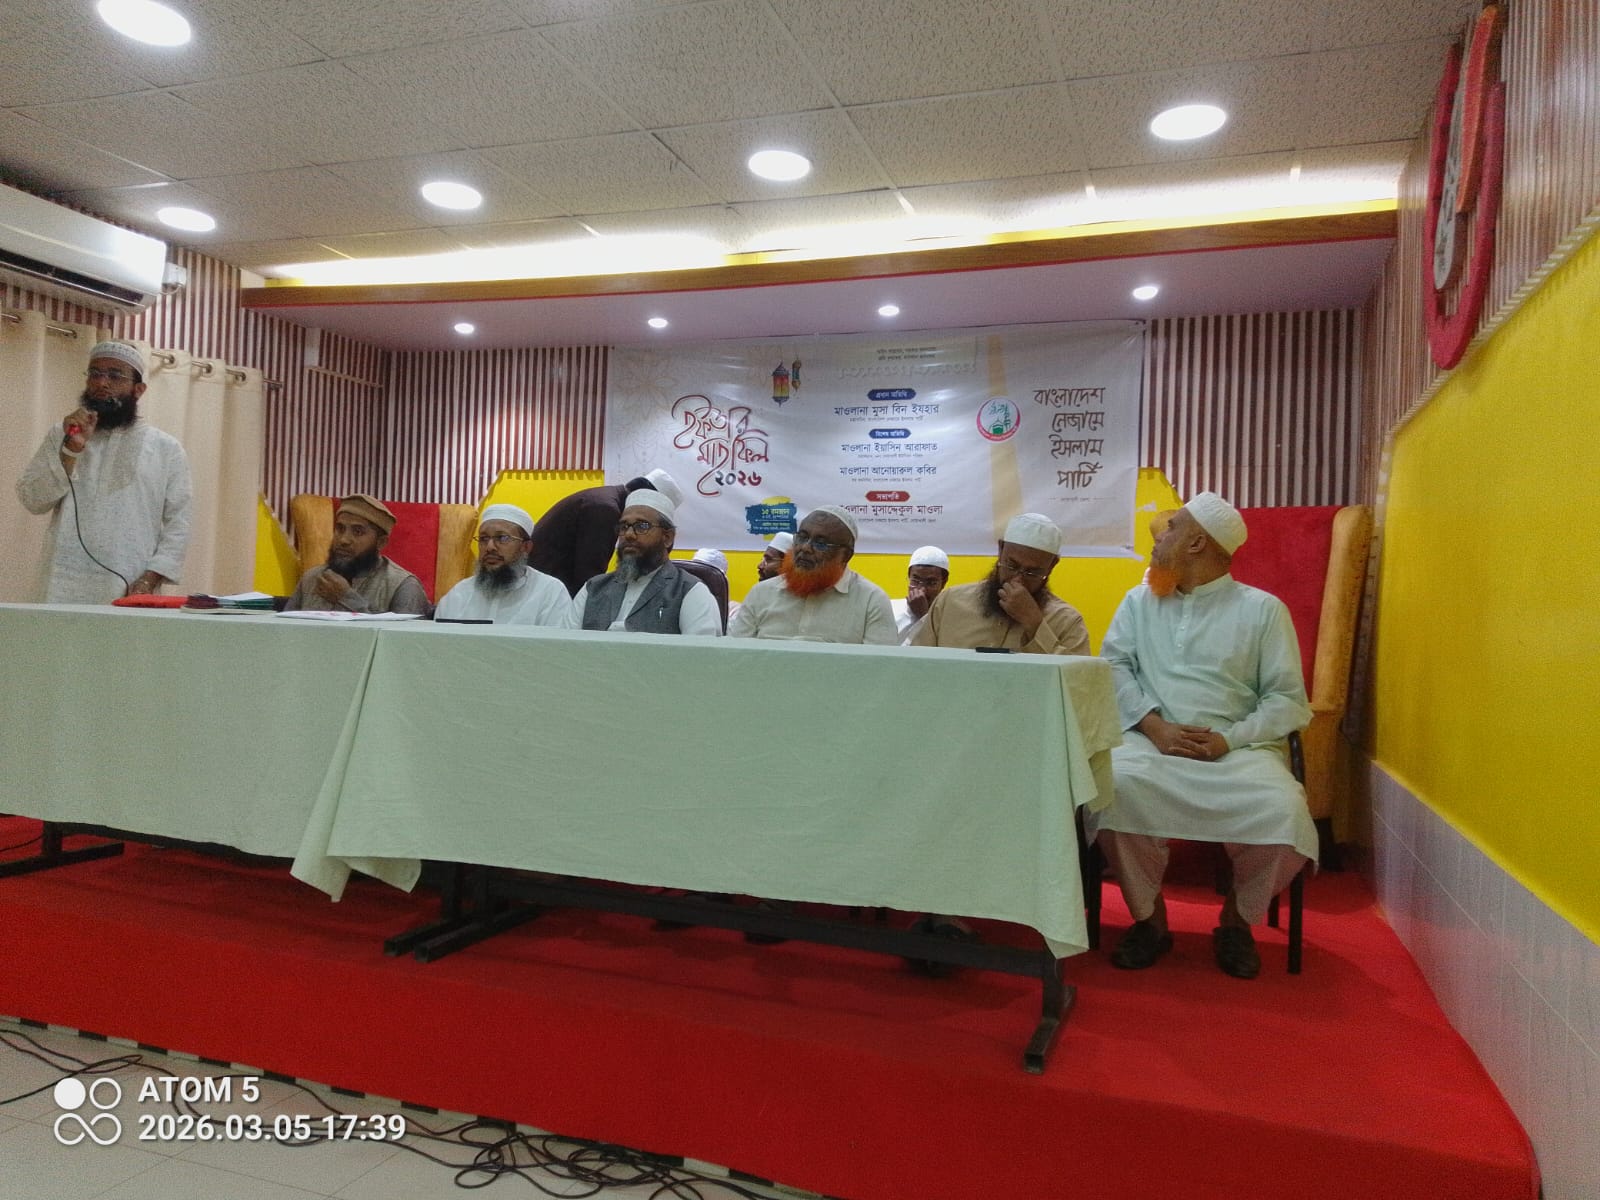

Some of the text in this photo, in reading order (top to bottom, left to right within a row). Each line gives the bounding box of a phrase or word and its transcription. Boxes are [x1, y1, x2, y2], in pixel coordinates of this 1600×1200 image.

[1032, 387, 1106, 408] বাংলাদেশ
[834, 405, 869, 417] মাওলানা
[872, 405, 889, 417] মুসা
[891, 403, 908, 416] বিন
[1052, 410, 1105, 433] নেজামে
[840, 443, 871, 453] মাওলানা
[1048, 433, 1105, 460] ইসলাম
[714, 470, 763, 487] ২০২৬
[839, 466, 869, 477] মাওলানা
[916, 464, 938, 476] কবির
[1056, 461, 1104, 490] পার্টি
[916, 503, 944, 515] মাওলা
